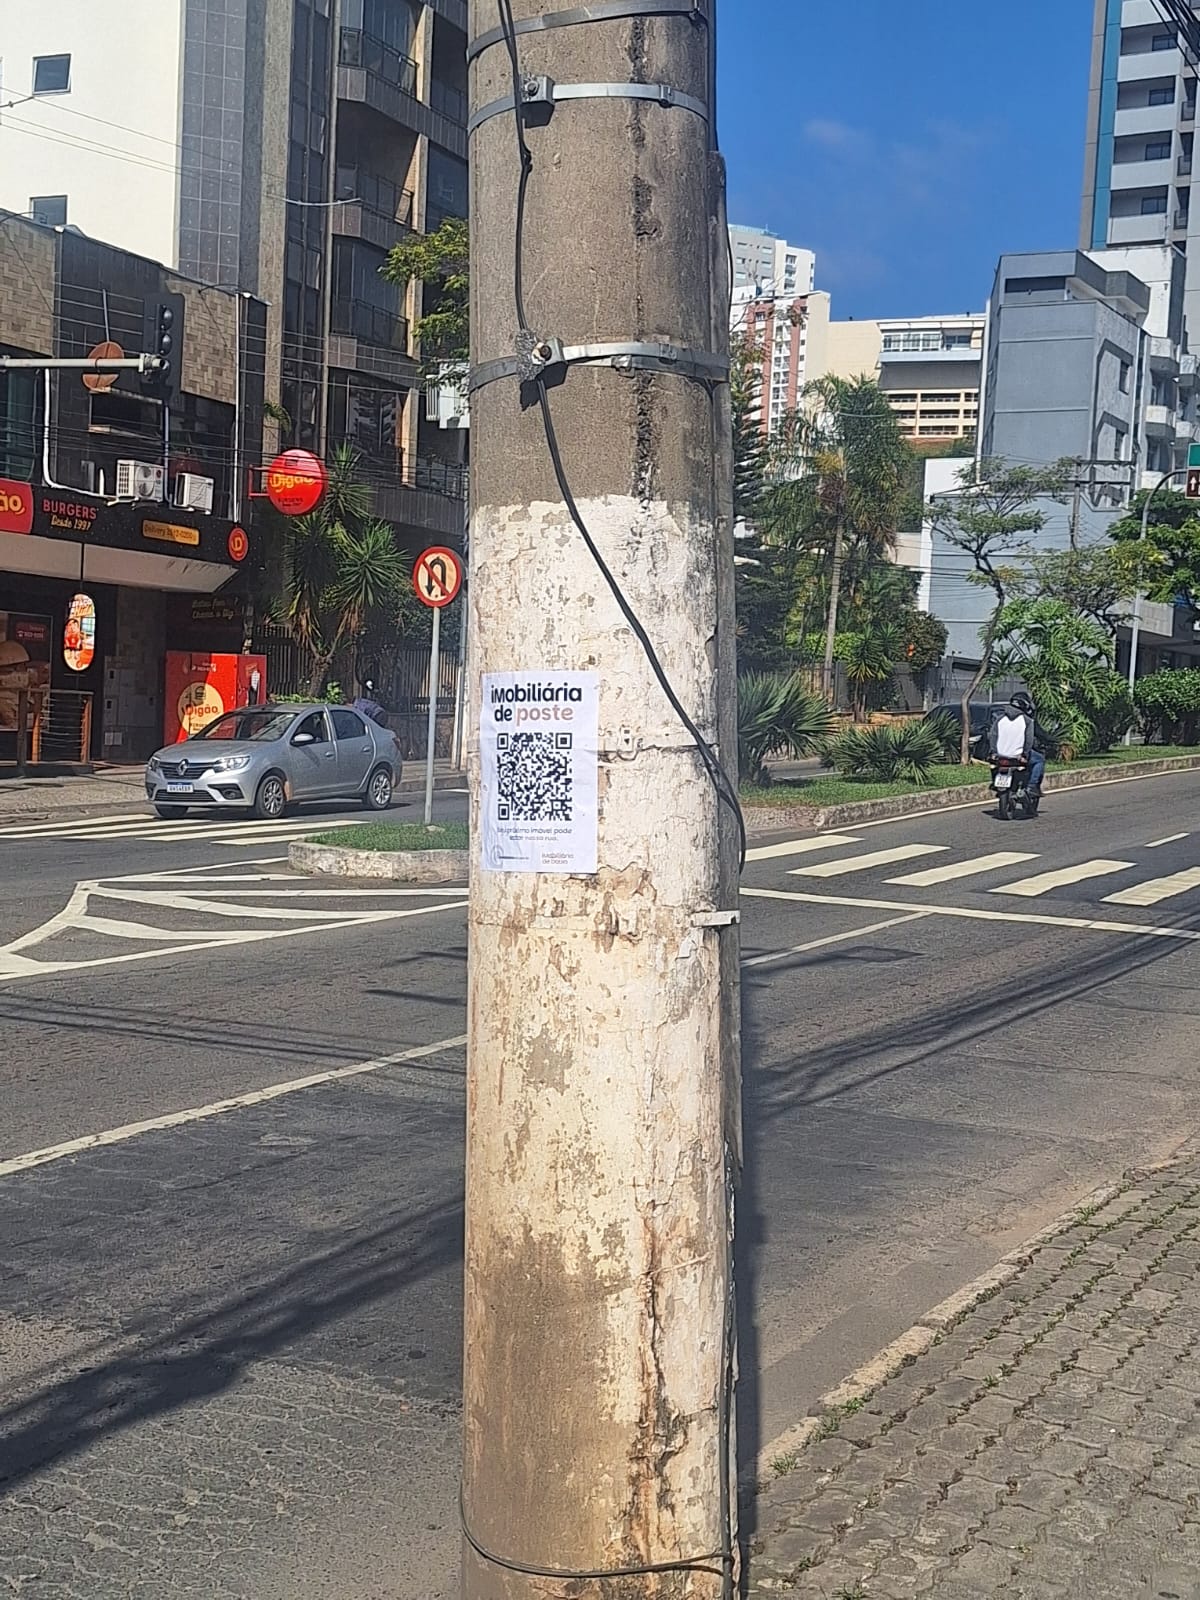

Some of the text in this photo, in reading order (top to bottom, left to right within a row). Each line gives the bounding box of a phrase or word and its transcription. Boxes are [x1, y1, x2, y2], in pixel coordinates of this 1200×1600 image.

[43, 499, 97, 520] BURGERS
[74, 518, 91, 531] 1997
[491, 682, 582, 703] iMobiliária
[494, 704, 574, 726] de poste
